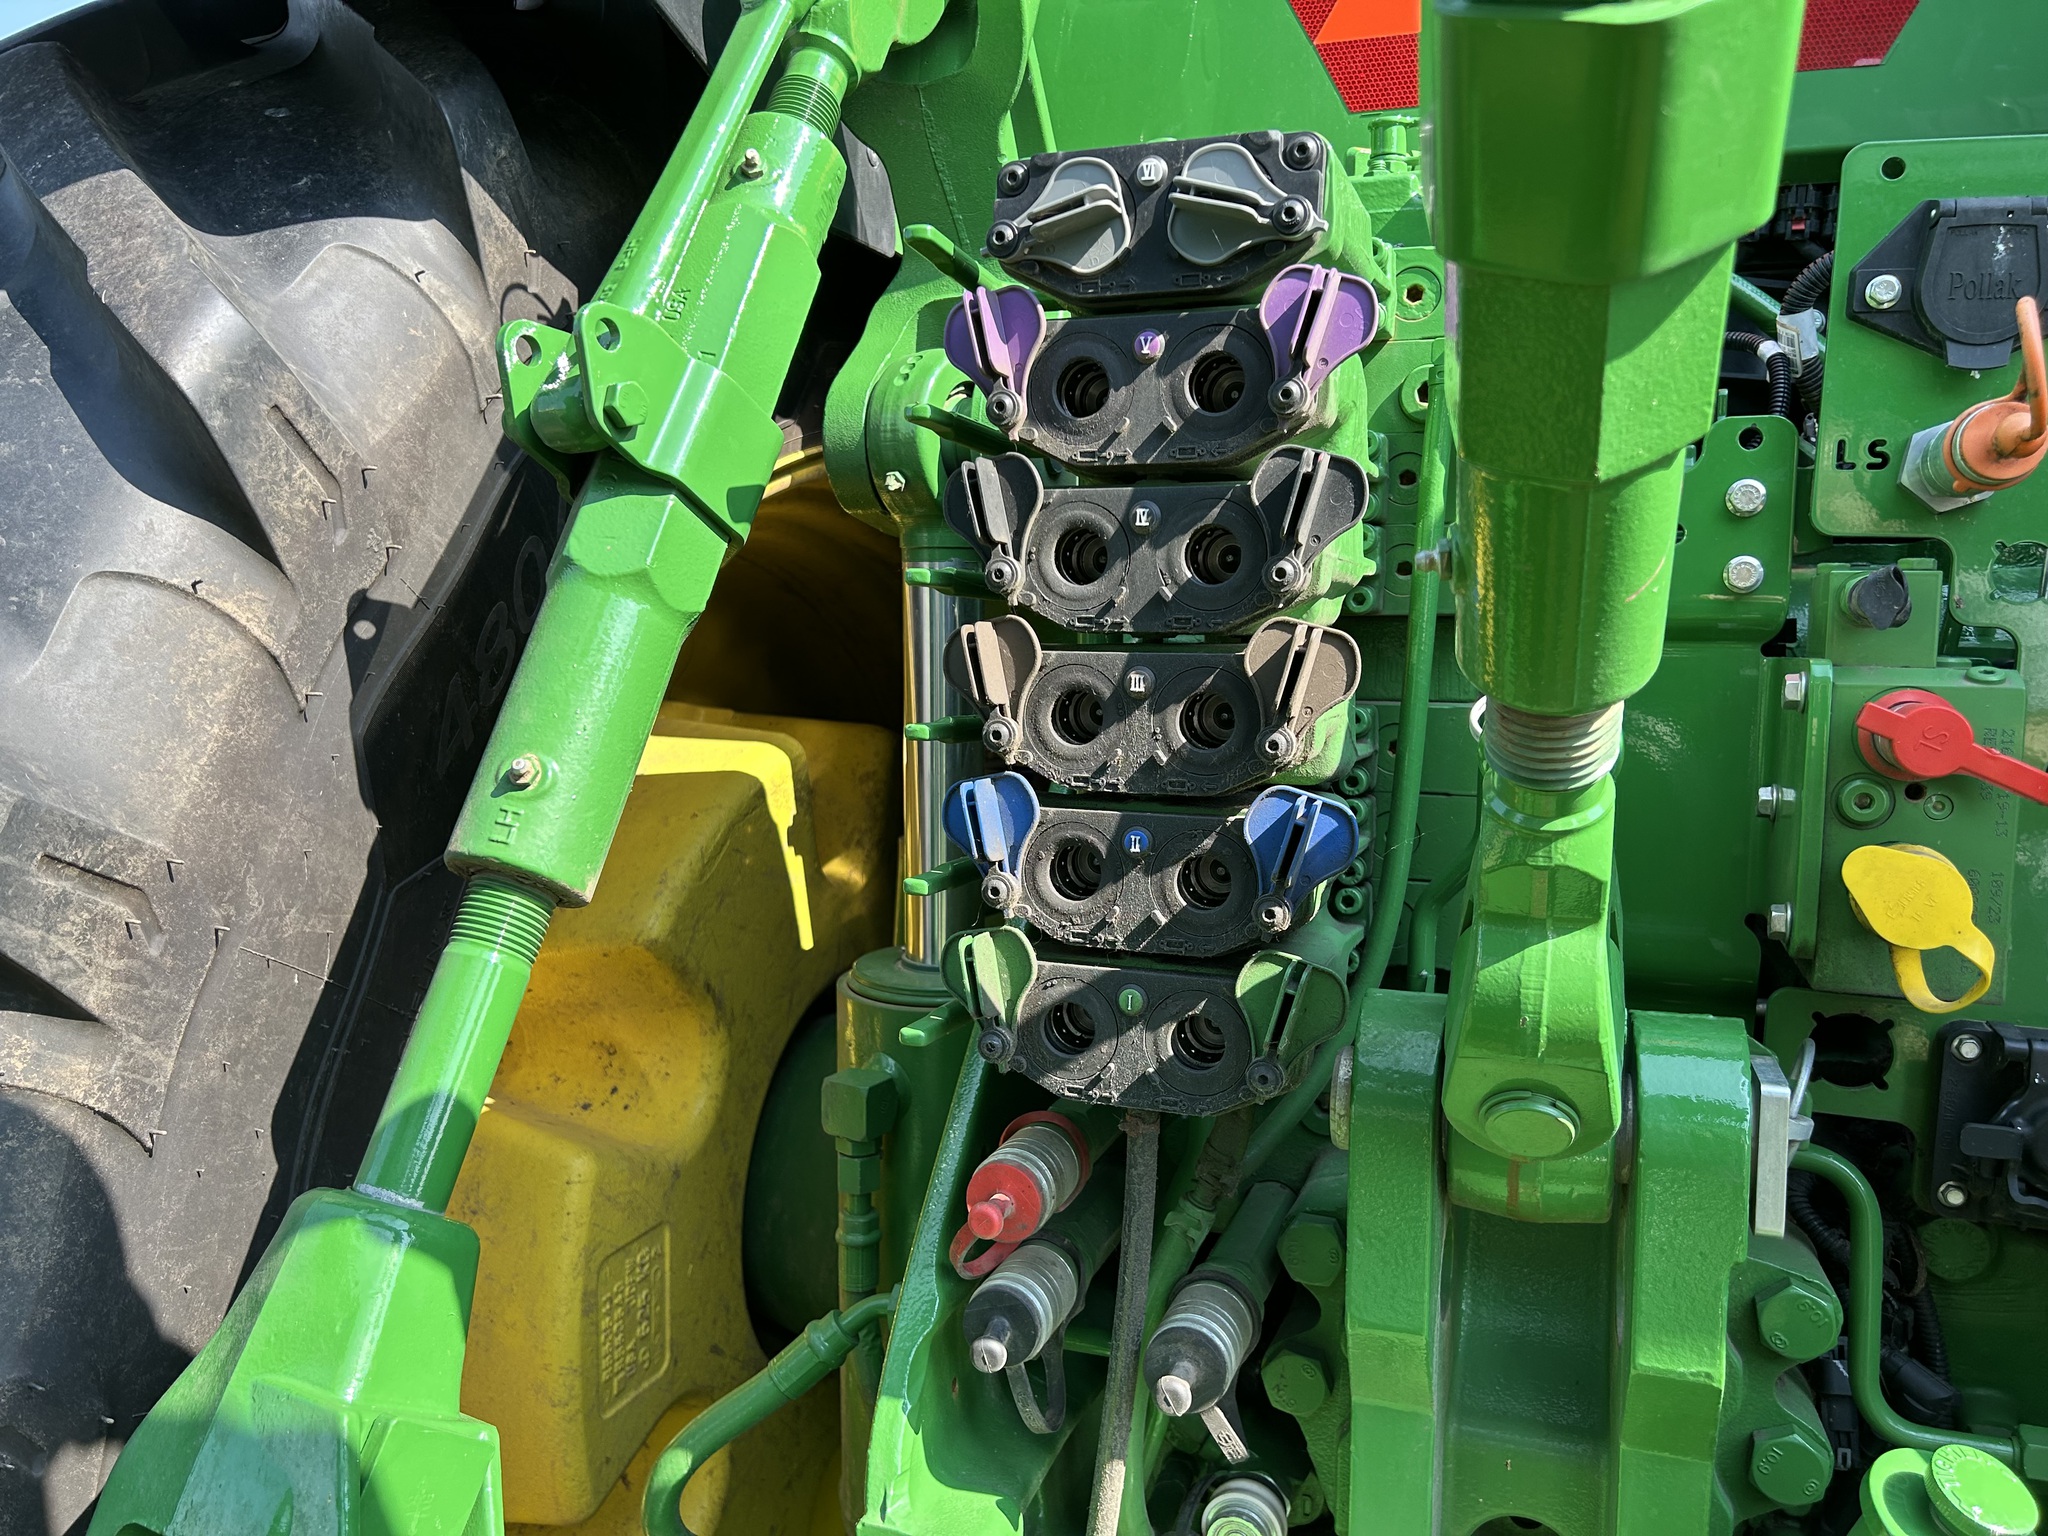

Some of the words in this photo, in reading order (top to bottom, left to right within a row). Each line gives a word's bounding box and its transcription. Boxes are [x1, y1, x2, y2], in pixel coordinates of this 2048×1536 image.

[1141, 162, 1156, 181] VI
[1947, 271, 2022, 301] Pollak
[661, 287, 692, 322] USA
[1139, 336, 1153, 354] V
[1134, 507, 1150, 527] IV
[1129, 674, 1145, 693] III
[488, 805, 525, 846] LH
[1129, 835, 1141, 853] II
[1757, 1446, 1784, 1476] 10.9
